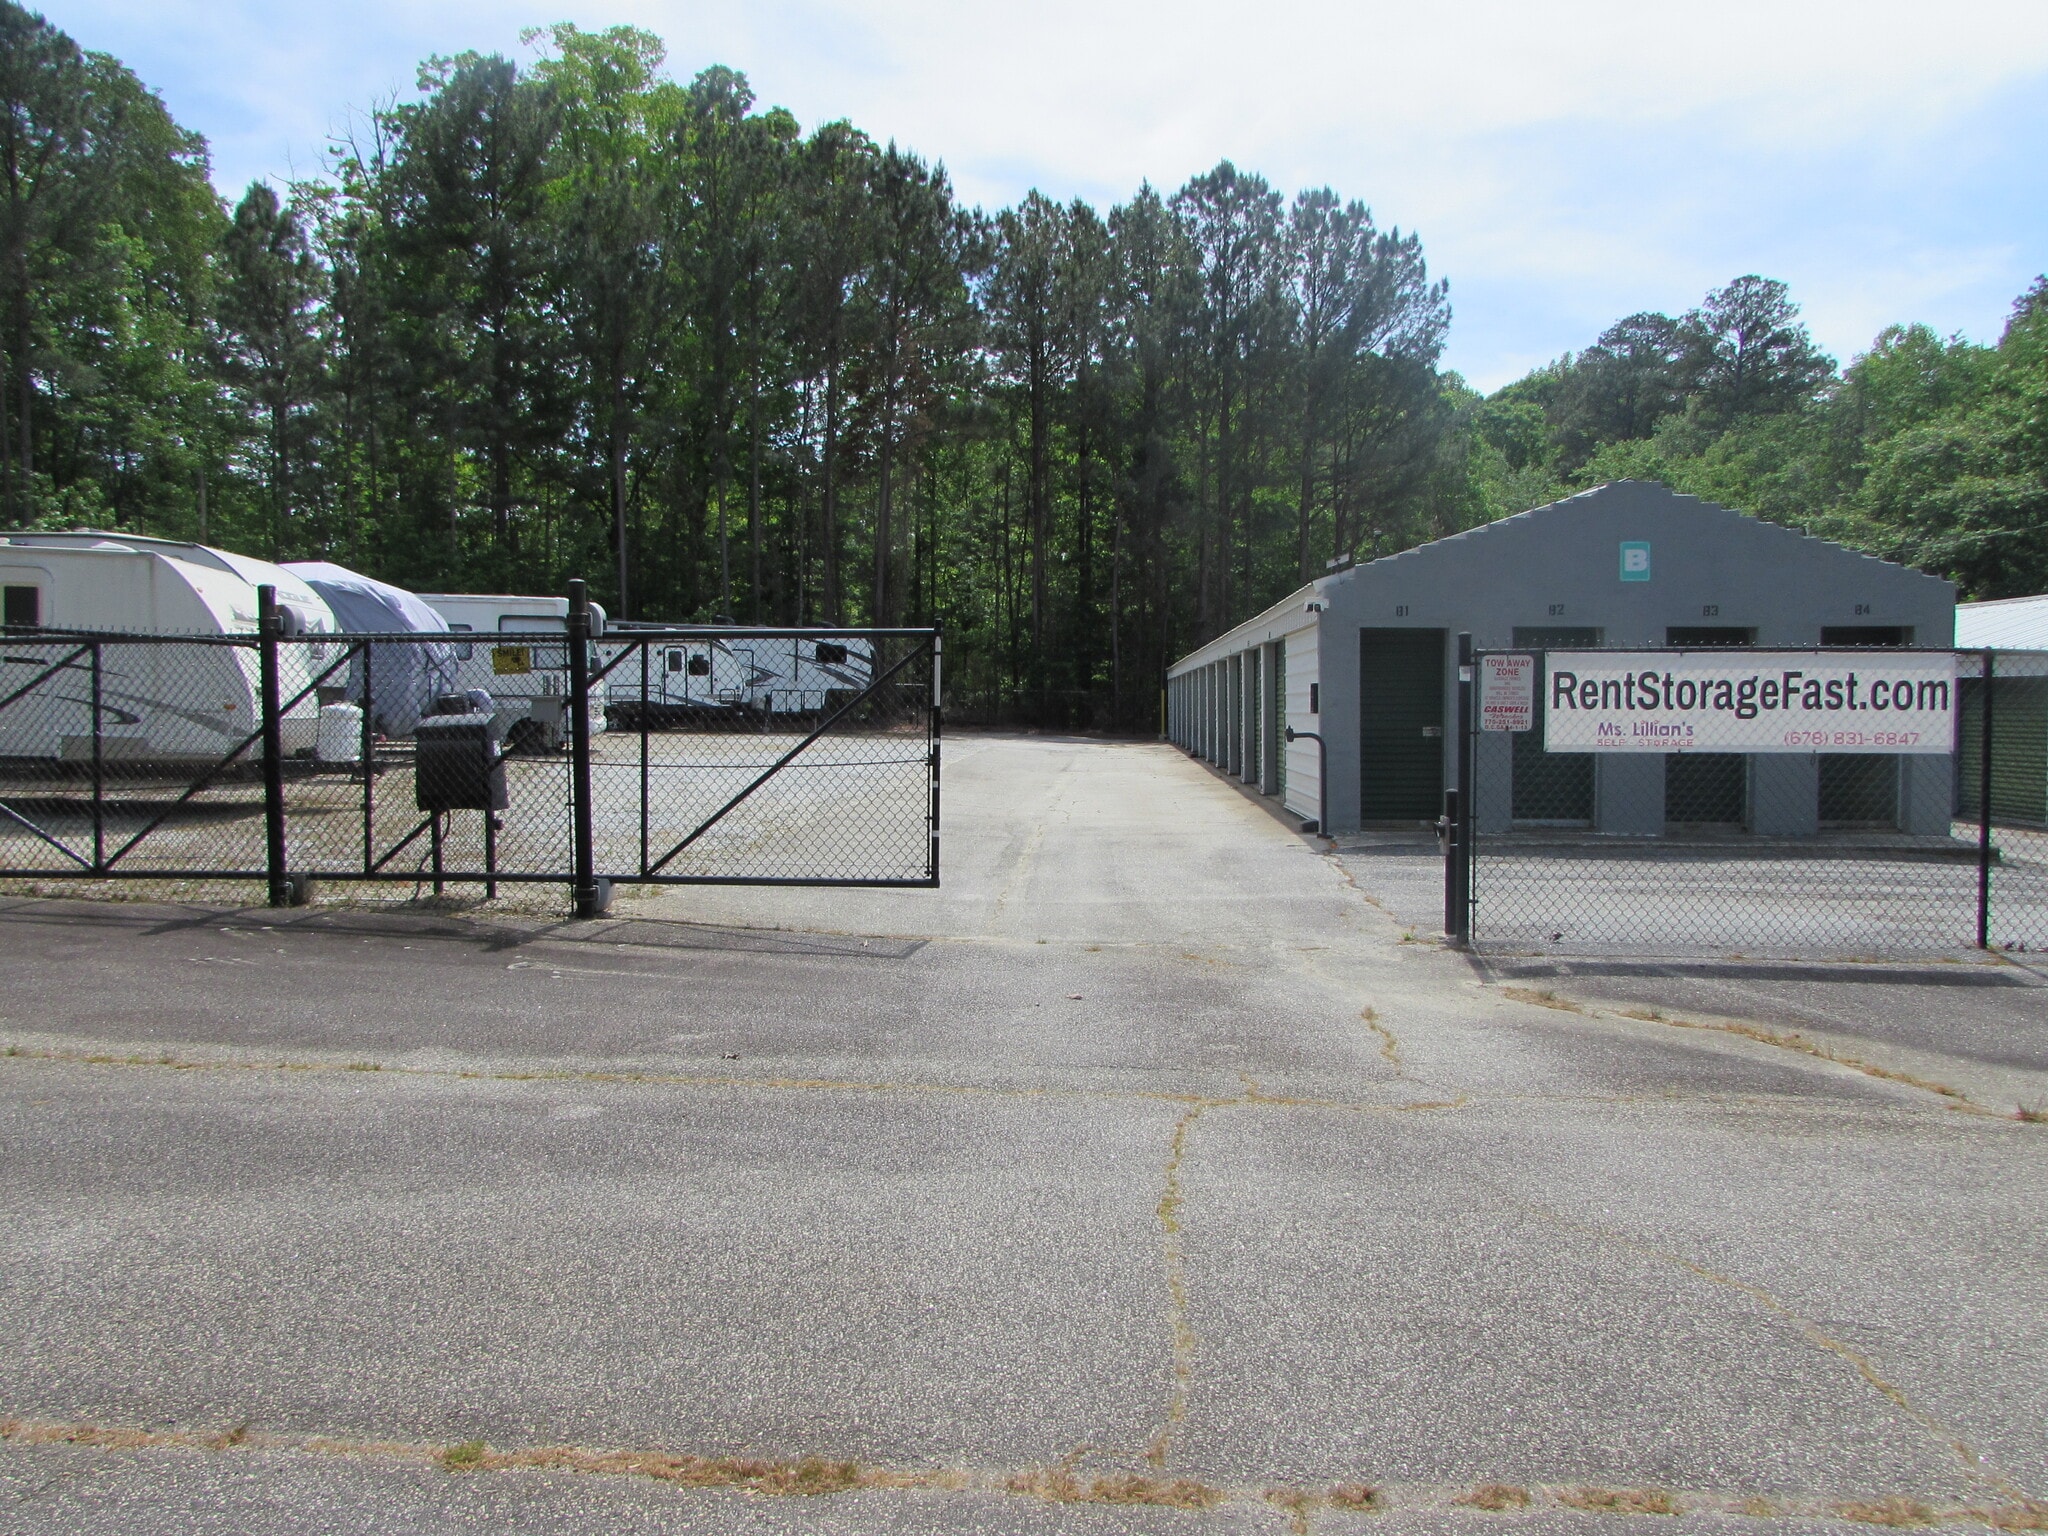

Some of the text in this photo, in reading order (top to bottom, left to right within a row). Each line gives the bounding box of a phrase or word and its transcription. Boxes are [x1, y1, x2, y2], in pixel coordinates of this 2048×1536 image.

[1624, 549, 1648, 572] B
[1485, 659, 1531, 667] TOW AWAY
[1495, 668, 1519, 676] ZONE
[1551, 671, 1949, 720] RentStorageFast.com
[1597, 720, 1694, 737] Ms. Lillian's
[1597, 738, 1626, 747] SELF
[1638, 738, 1694, 747] STORAGE
[1784, 731, 1920, 746] (678) 831-6847
